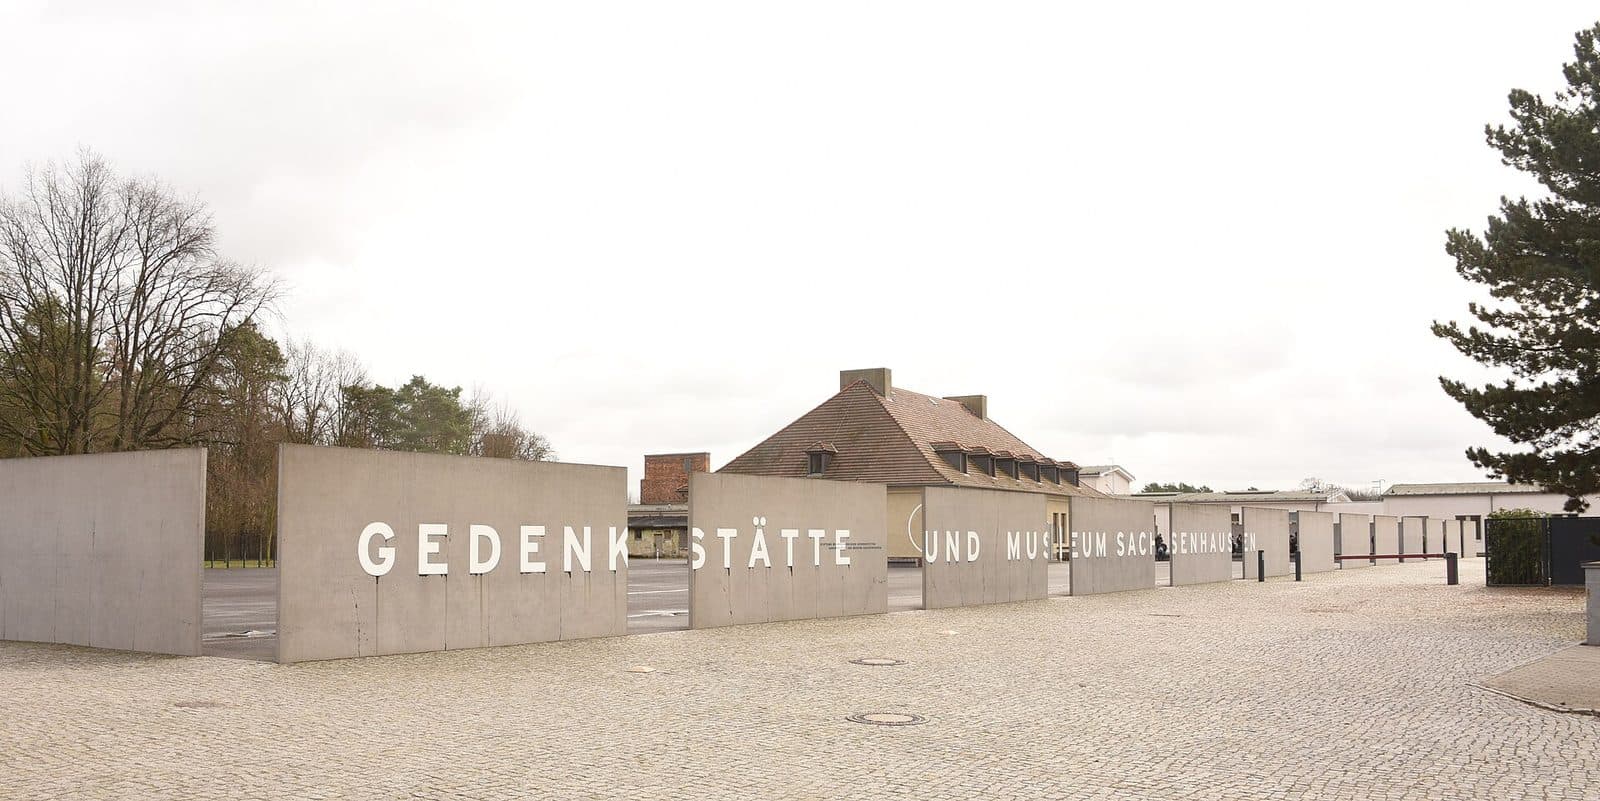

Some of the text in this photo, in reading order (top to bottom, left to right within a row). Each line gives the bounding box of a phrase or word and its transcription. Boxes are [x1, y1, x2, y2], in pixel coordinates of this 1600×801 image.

[358, 521, 629, 576] GEDENK
[692, 516, 850, 570] STÄTTE
[925, 530, 981, 563] UND
